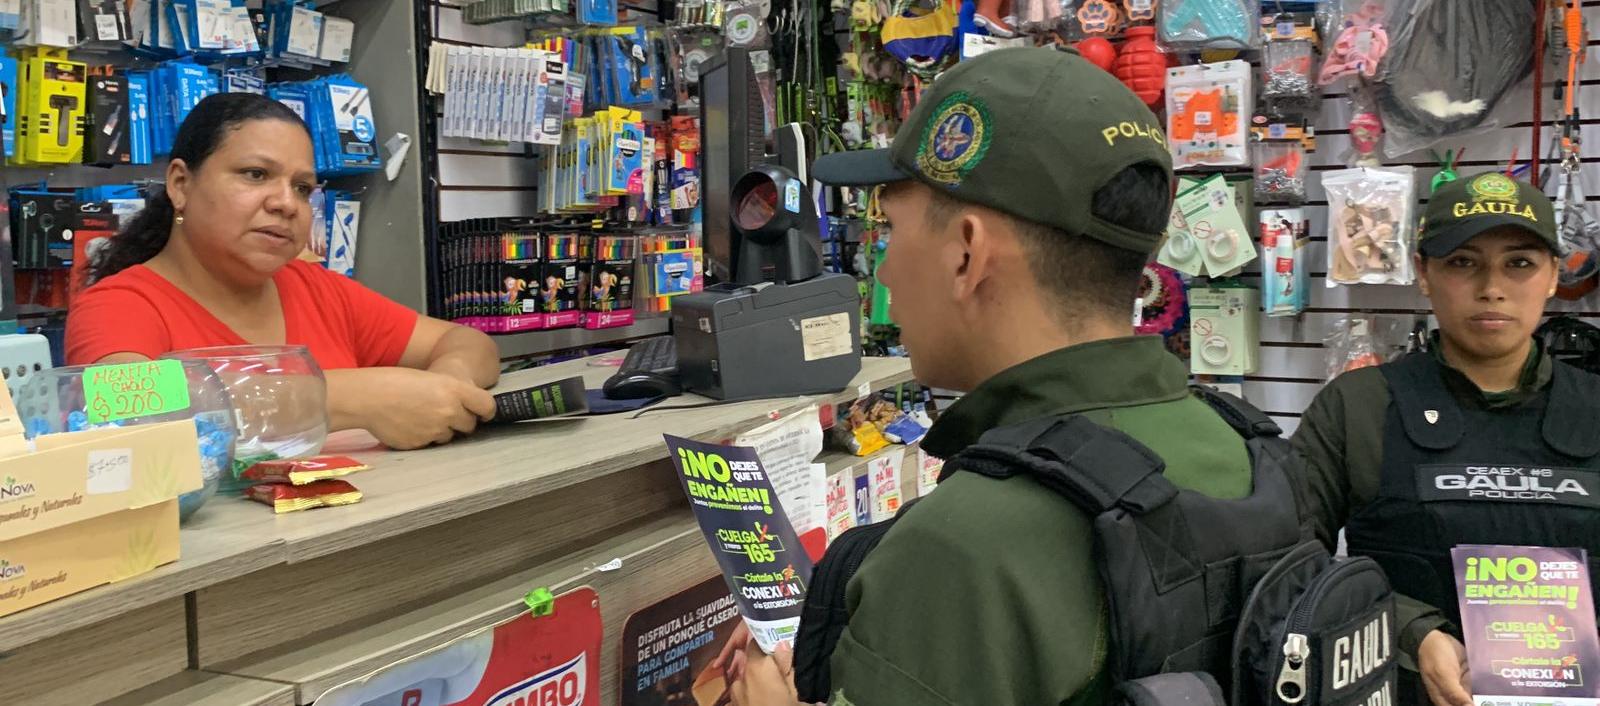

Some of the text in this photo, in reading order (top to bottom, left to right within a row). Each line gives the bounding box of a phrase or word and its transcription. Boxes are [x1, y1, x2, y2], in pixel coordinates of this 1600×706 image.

[1102, 121, 1172, 154] POLICI
[1453, 202, 1537, 222] GAULA
[116, 390, 163, 415] 200
[678, 447, 731, 483] ¡NO
[729, 461, 759, 472] DEJES
[1466, 466, 1524, 476] CEAEX
[733, 472, 763, 482] QUE TE
[1435, 475, 1589, 496] GAULA
[718, 529, 760, 543] CUELGA
[743, 543, 775, 564] 165
[1465, 557, 1538, 581] ¡NO
[1540, 561, 1577, 570] DEJES
[1540, 571, 1579, 580] QUE TE
[1465, 582, 1579, 609] ENGAÑEN!
[638, 620, 681, 648] DISFRUTA
[683, 612, 695, 626] LA
[638, 647, 650, 662] DE
[653, 640, 666, 654] UN
[707, 605, 739, 628] CASERO
[1491, 621, 1548, 633] CUELGA
[1524, 633, 1561, 650] 165
[638, 631, 715, 676] PARA COMPARTIR
[637, 657, 689, 691] EN FAMILIA
